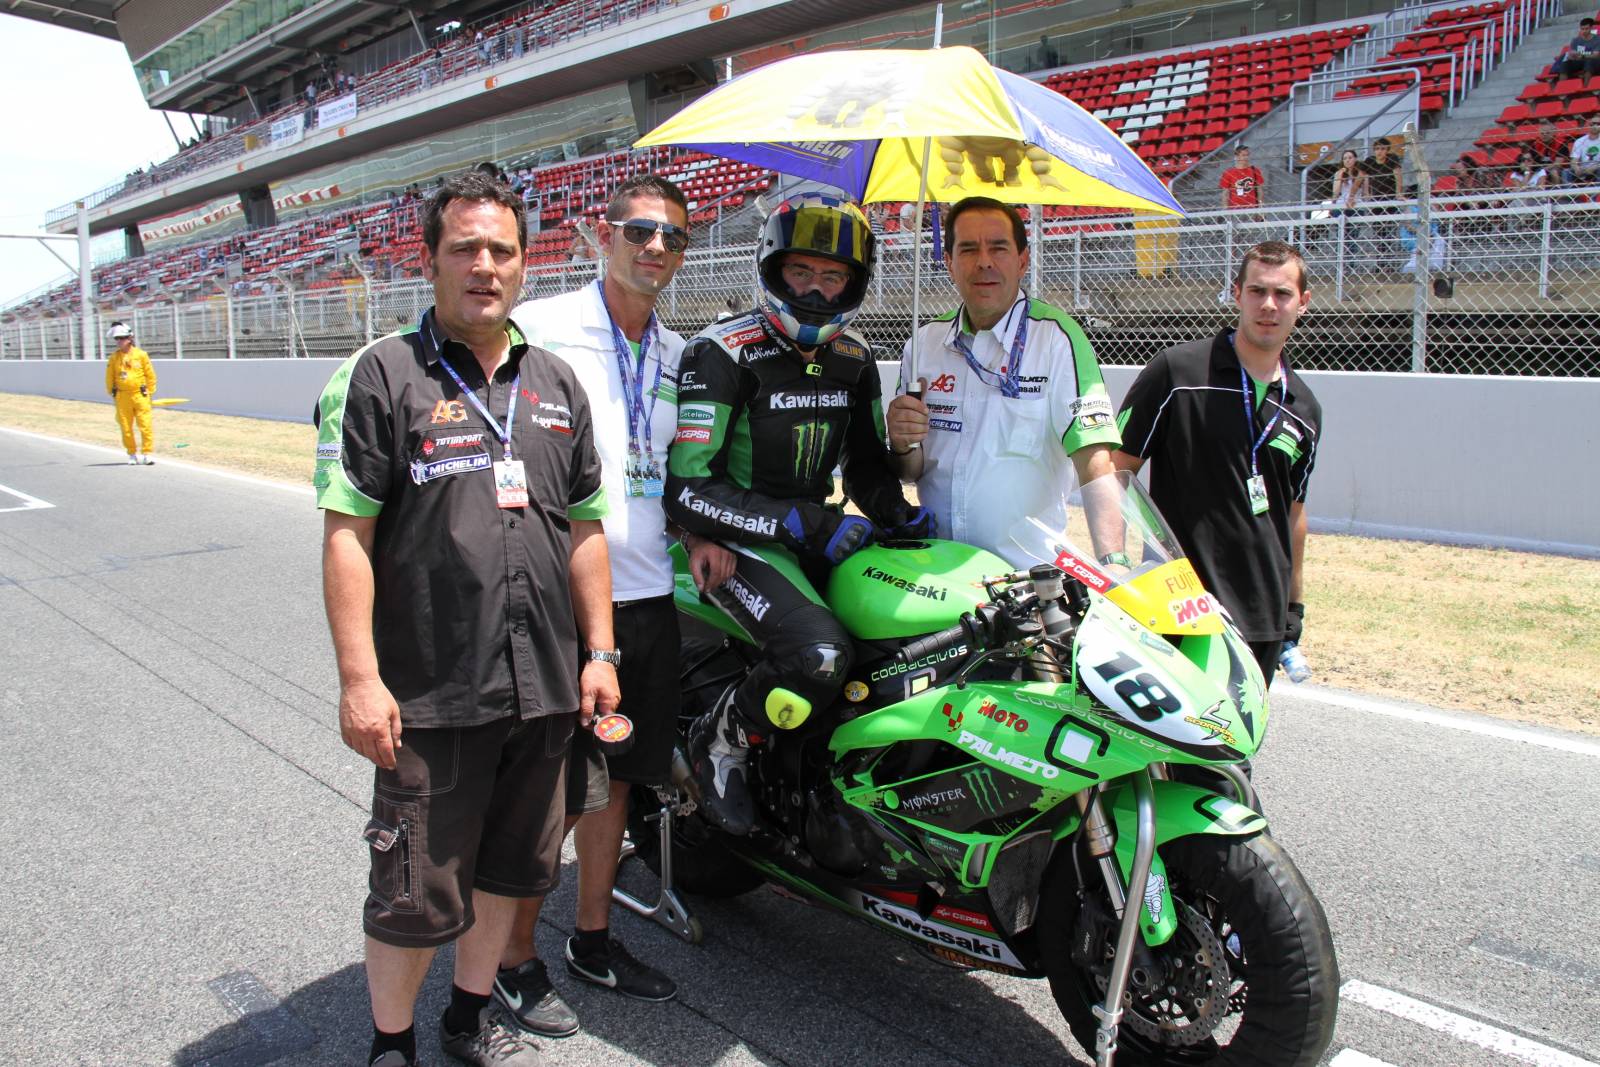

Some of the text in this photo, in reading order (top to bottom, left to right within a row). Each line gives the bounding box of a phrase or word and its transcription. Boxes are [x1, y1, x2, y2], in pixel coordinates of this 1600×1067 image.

[722, 5, 728, 17] 7
[770, 391, 848, 409] Kawasaki
[429, 457, 488, 475] MICHELIN
[678, 486, 778, 536] Kawasaki
[862, 566, 947, 601] Kawasaki
[1073, 564, 1105, 588] CEPSA
[1093, 650, 1182, 722] 18
[978, 703, 1029, 733] MOTO
[957, 730, 1059, 779] PALMETO
[861, 894, 1000, 959] Kawasaki
[952, 912, 987, 926] CEPSA
